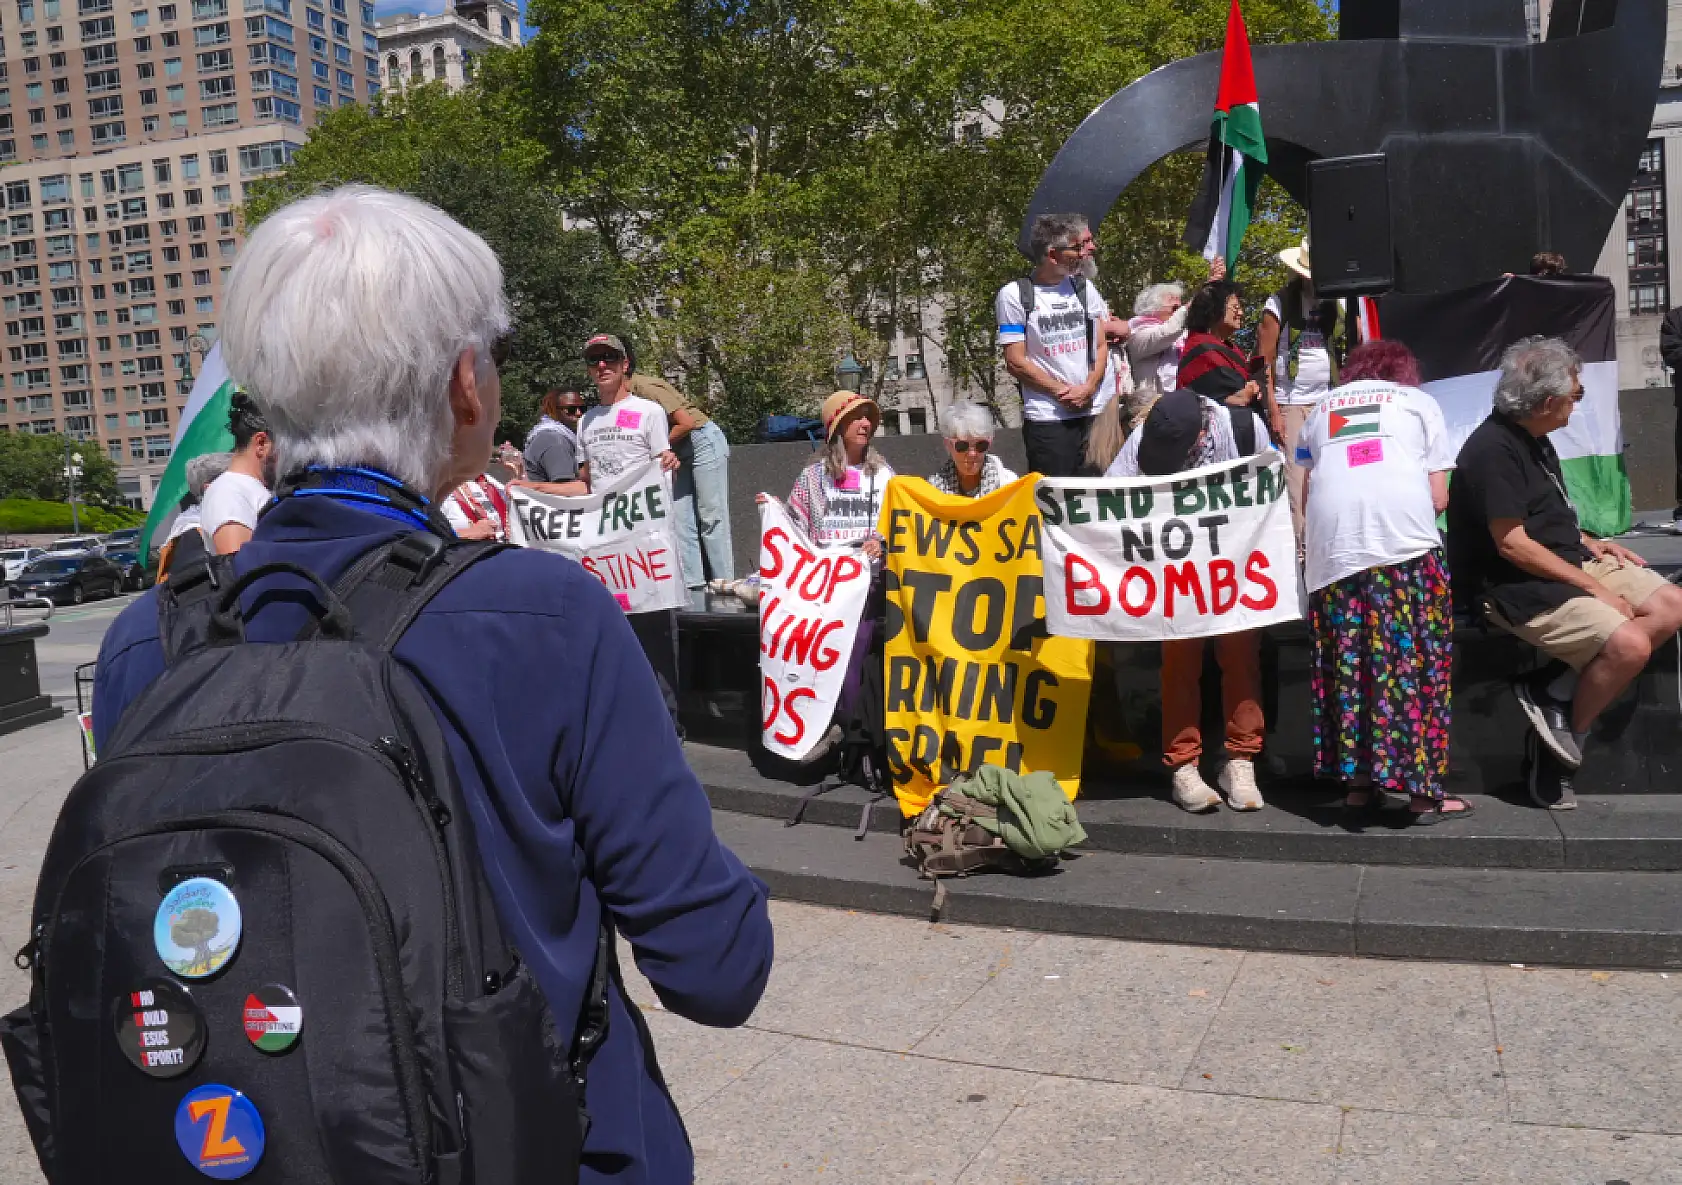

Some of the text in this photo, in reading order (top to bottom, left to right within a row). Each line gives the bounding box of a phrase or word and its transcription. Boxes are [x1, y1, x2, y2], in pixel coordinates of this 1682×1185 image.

[1321, 393, 1393, 413] GENOCIDE
[513, 483, 667, 541] FREE FREE
[1037, 486, 1153, 526] SEND
[1121, 514, 1229, 562] NOT
[760, 526, 863, 603] STOP
[1064, 549, 1279, 618] BOMBS
[760, 591, 844, 672] LING
[884, 567, 1049, 652] STOP
[888, 655, 1060, 730] RMING
[187, 1095, 246, 1161] Z
